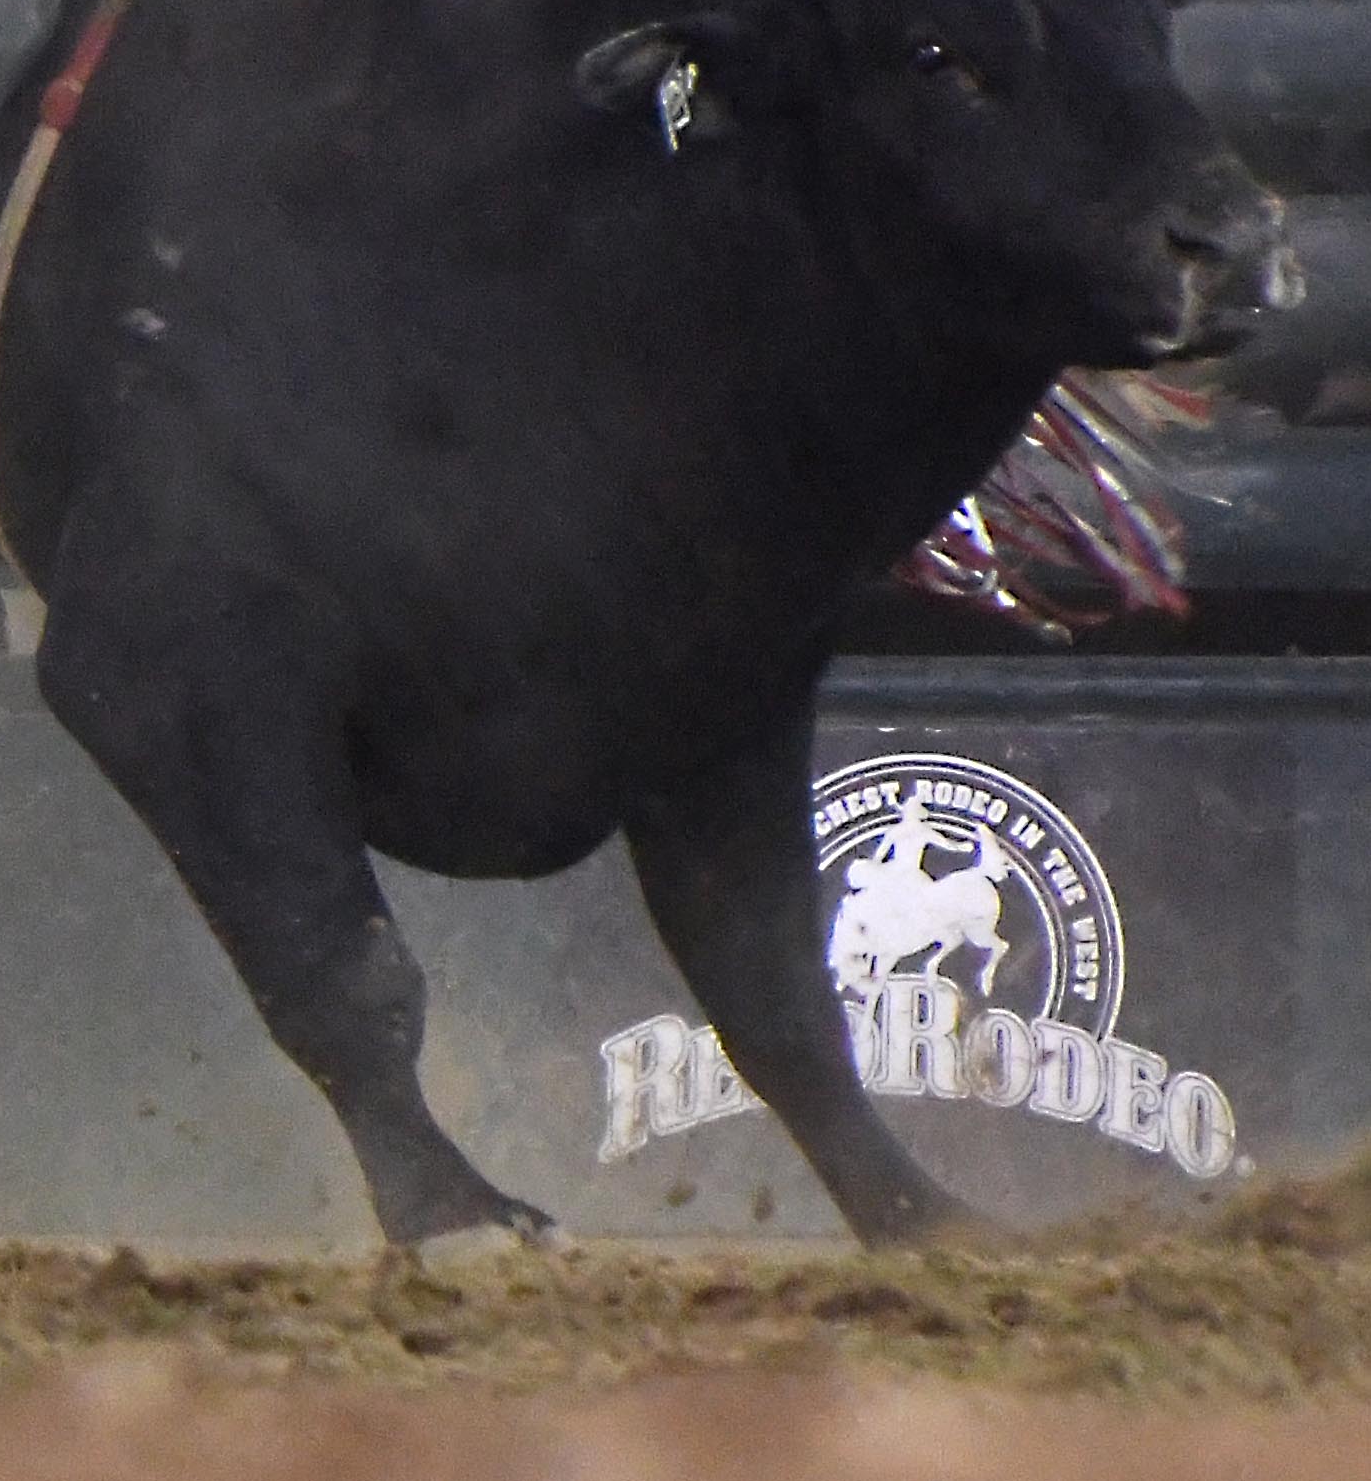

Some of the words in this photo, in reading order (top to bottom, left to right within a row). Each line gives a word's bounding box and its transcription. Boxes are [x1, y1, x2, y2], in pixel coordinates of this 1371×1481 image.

[814, 781, 901, 838] CHEST
[915, 778, 1010, 825] RODEO
[1011, 815, 1046, 850] IN
[1043, 847, 1087, 907] THE
[1071, 916, 1101, 1002] WEST
